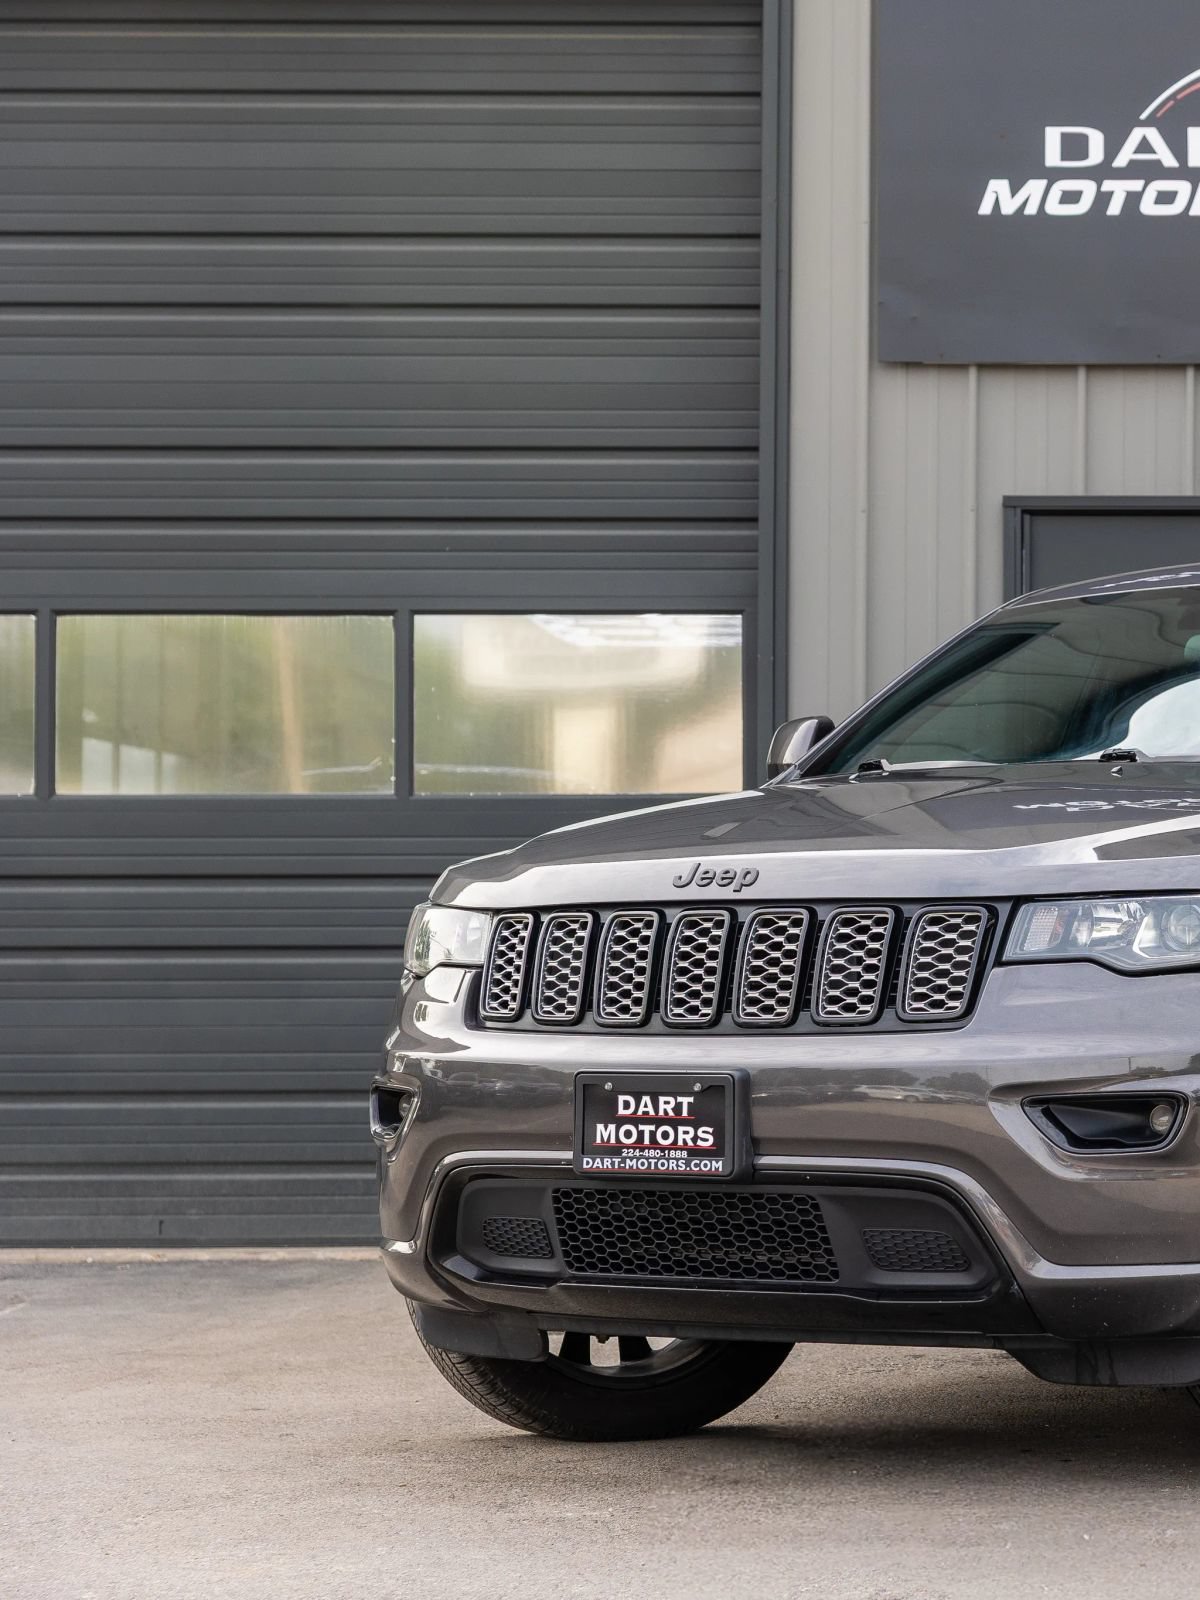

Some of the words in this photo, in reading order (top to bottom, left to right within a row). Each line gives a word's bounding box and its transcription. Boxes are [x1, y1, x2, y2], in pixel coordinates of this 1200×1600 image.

[673, 863, 760, 893] Jeep
[617, 1095, 694, 1118] DART
[595, 1123, 714, 1147] MOTORS
[582, 1157, 723, 1172] DART-MOTORS.COM
[621, 1148, 688, 1159] 224-480-1888
